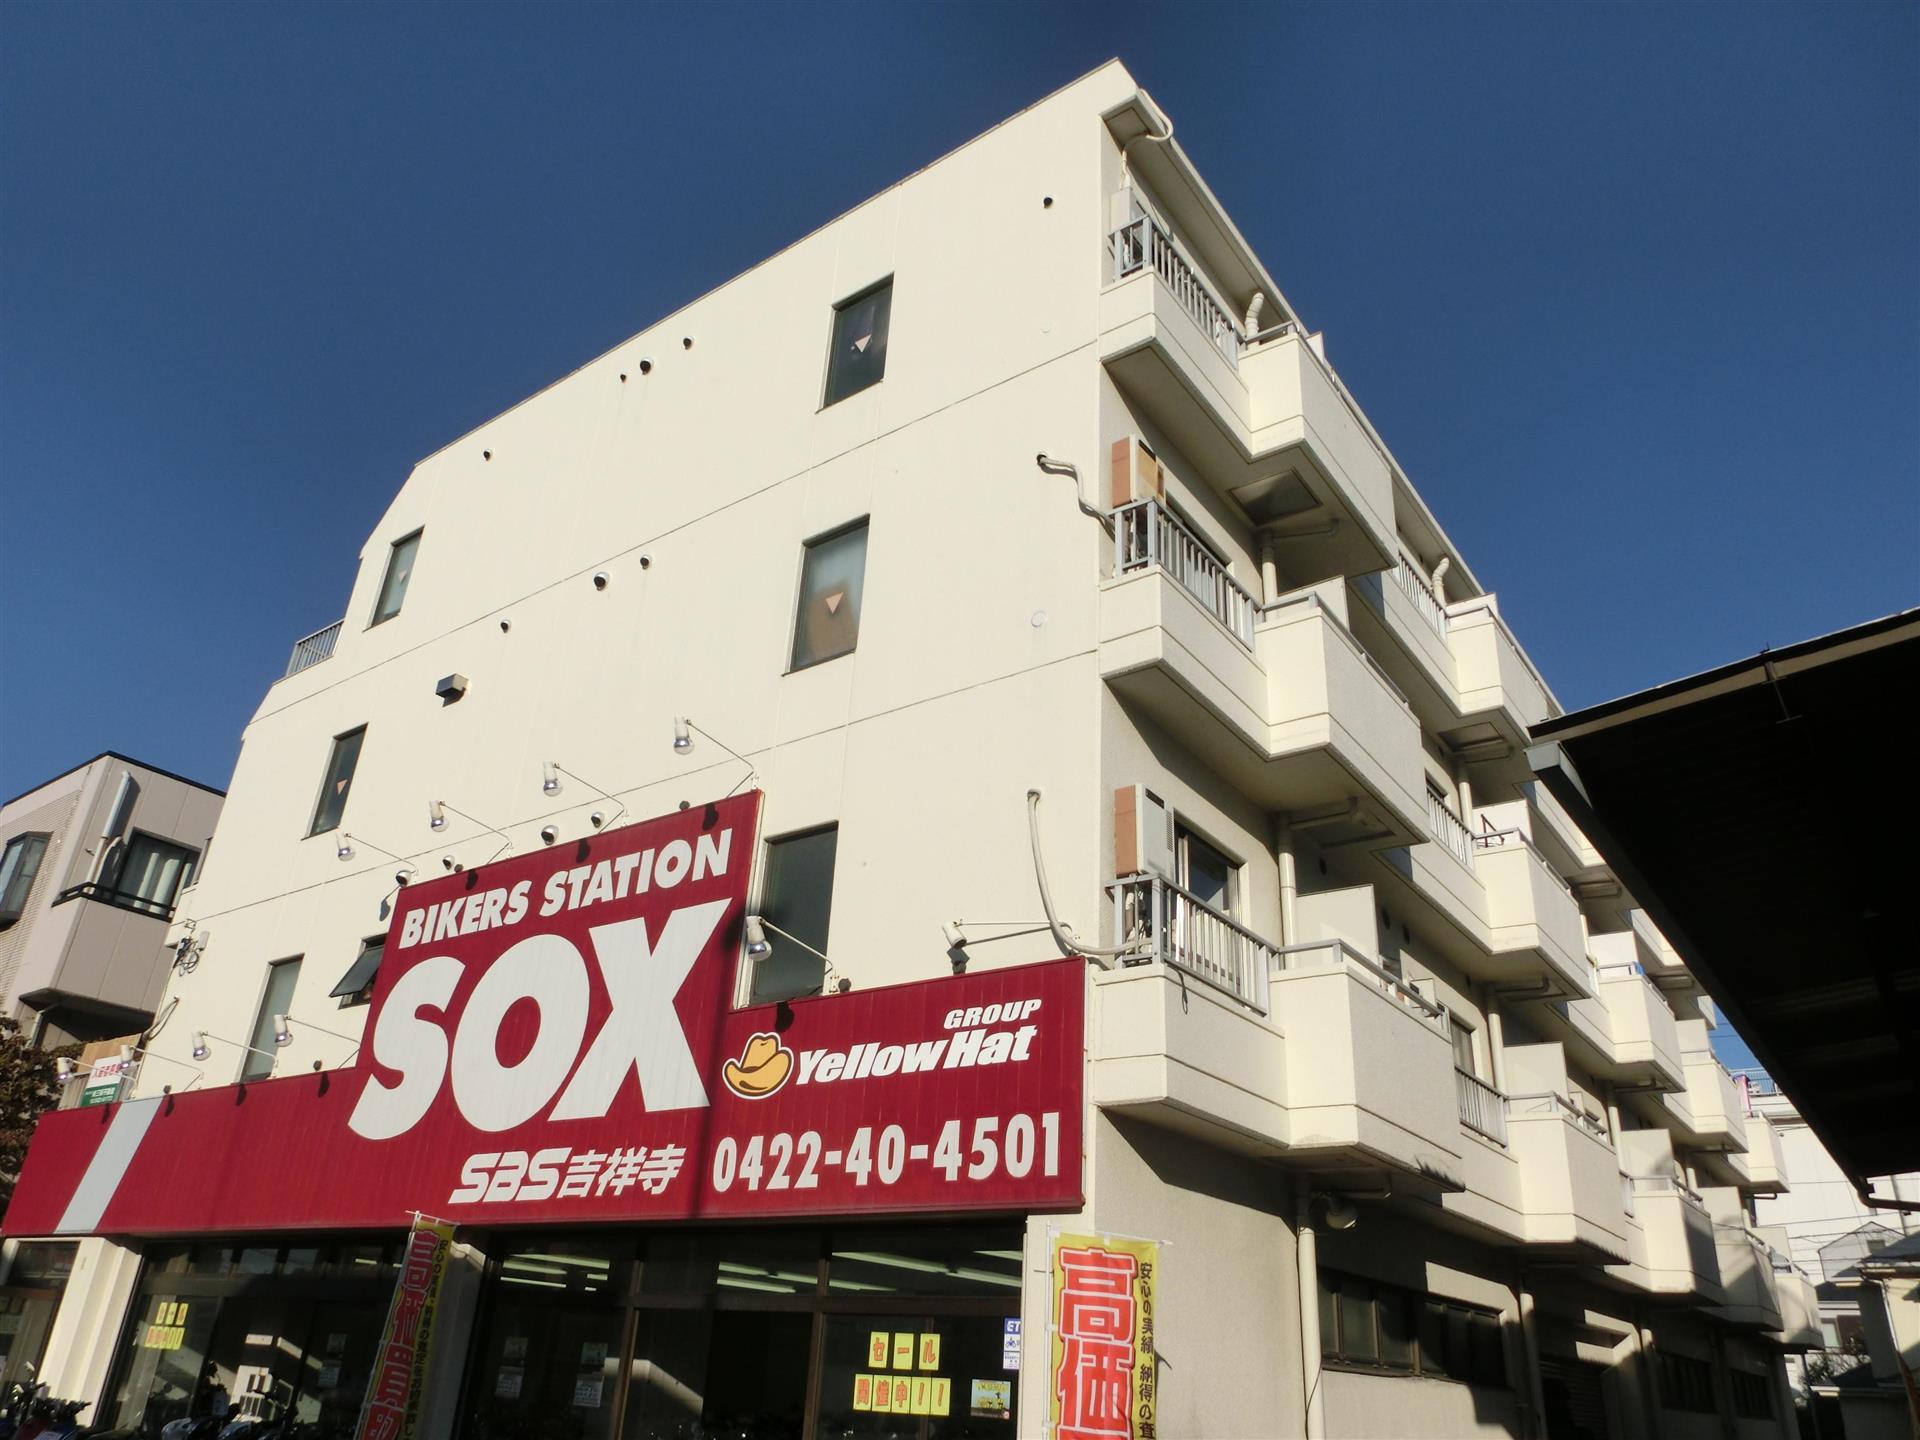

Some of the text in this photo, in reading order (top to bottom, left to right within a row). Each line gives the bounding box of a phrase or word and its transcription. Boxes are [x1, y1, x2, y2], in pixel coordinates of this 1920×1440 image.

[399, 828, 733, 950] BIKERS STATION
[347, 898, 733, 1141] SOX
[943, 998, 1042, 1030] GROUP
[712, 1111, 1060, 1193] 0422-40-4501
[873, 1337, 936, 1364] セール
[1056, 1247, 1139, 1440] 高価
